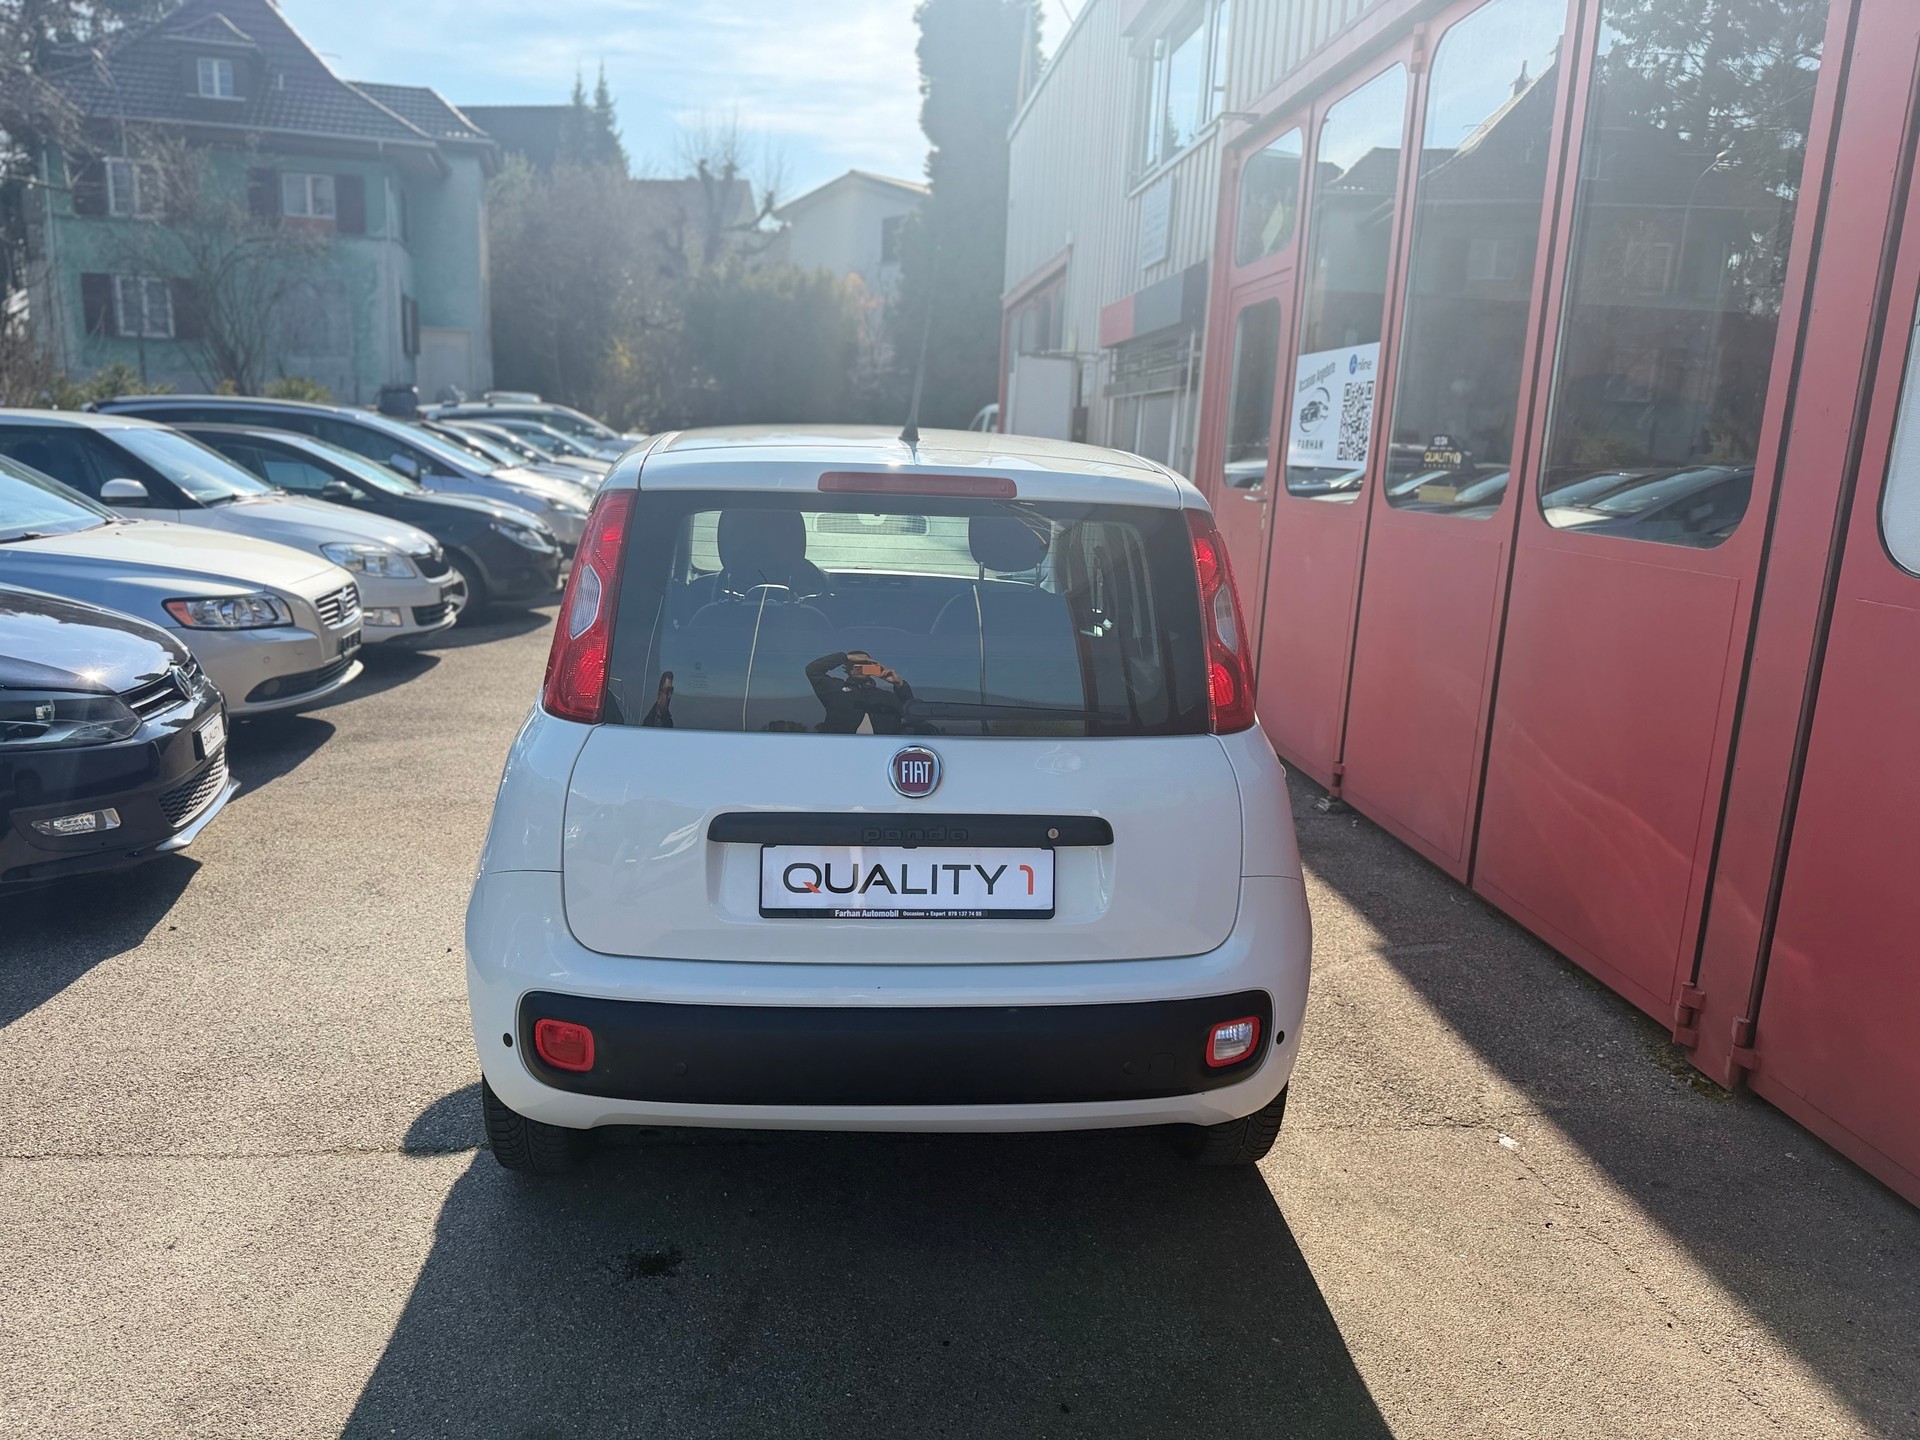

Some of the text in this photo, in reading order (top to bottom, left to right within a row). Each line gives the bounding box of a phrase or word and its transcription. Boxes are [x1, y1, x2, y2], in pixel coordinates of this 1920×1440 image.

[1297, 439, 1324, 451] FARHAN
[1424, 451, 1454, 463] QUALITY
[901, 761, 931, 784] FIAT
[861, 826, 969, 843] panda
[782, 862, 1034, 896] QUALITY 1
[834, 909, 861, 918] Farhan
[862, 909, 899, 918] Automobil
[930, 910, 946, 918] Expert
